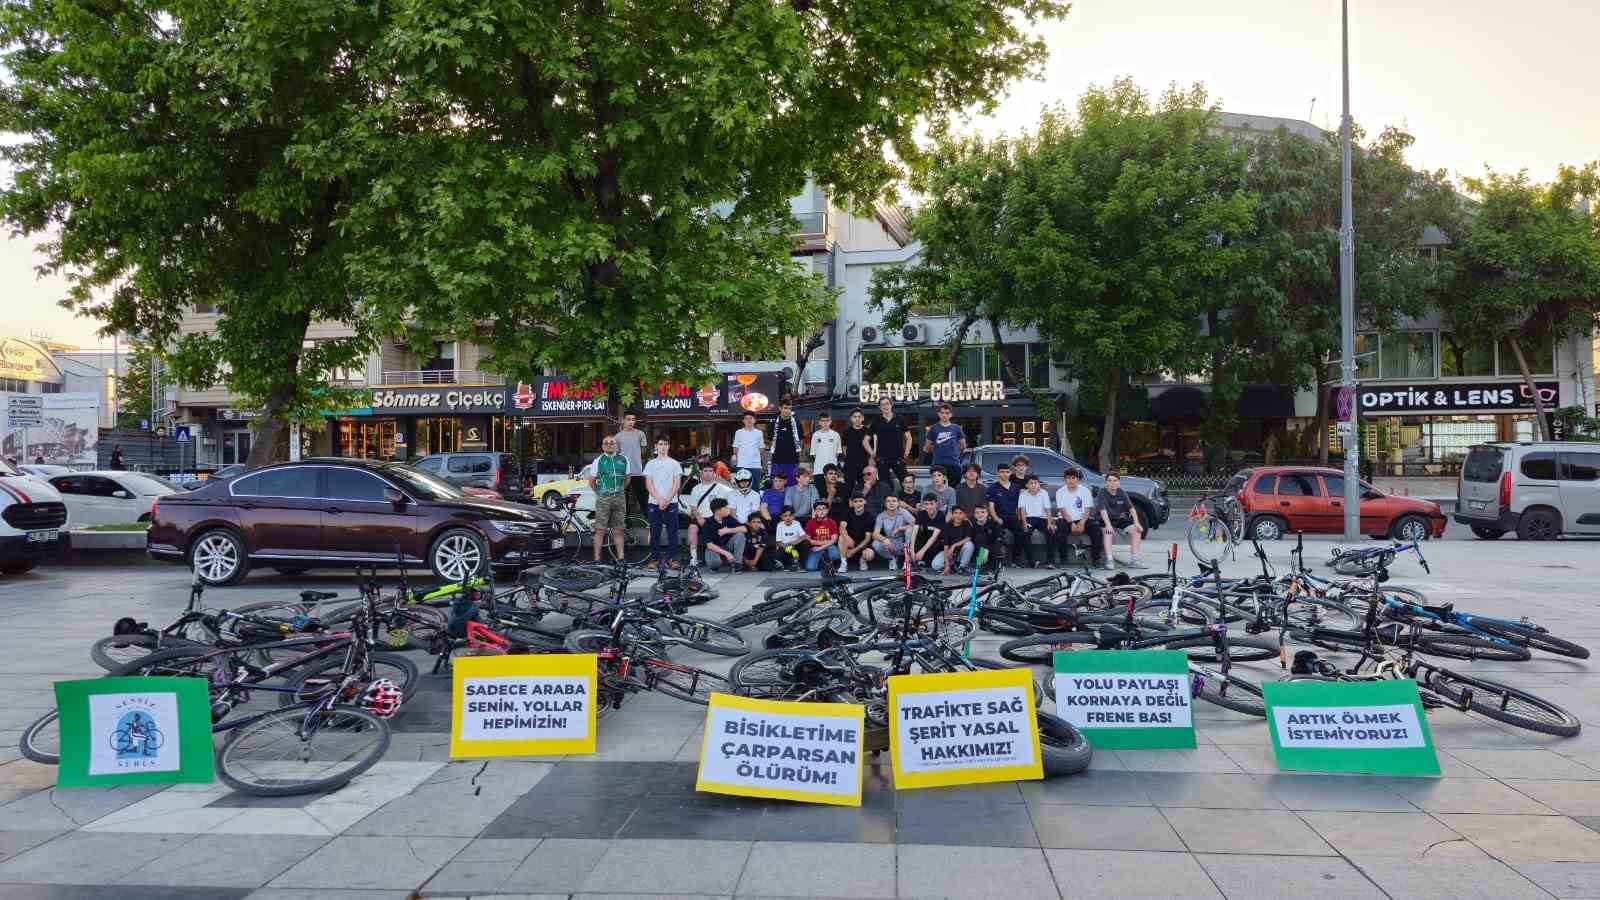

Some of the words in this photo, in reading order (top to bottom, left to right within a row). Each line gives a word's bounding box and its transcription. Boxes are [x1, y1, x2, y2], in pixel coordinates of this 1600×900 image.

[371, 390, 441, 408] Sönmez
[859, 382, 920, 403] CAJUN
[930, 380, 1006, 402] CORNER
[1362, 387, 1429, 407] OPTİK
[1433, 390, 1448, 406] &
[1454, 389, 1514, 406] LENS
[661, 398, 692, 409] SALONU
[466, 684, 528, 696] SADECE
[532, 684, 586, 695] ARABA
[1073, 679, 1113, 690] YOLU
[1117, 679, 1180, 694] PAYLAŞ!
[468, 698, 519, 713] SENİN.
[523, 701, 583, 712] YOLLAR
[1067, 695, 1142, 707] KORNAYA
[1145, 692, 1189, 707] DEĞİL
[901, 700, 983, 721] TRAFİKTE
[987, 696, 1024, 716] SAĞ
[483, 714, 568, 730] HEPİMİZİN!
[1086, 712, 1135, 723] FRENE
[1138, 712, 1173, 723] BAS!
[1287, 713, 1338, 725] ARTIK
[1341, 711, 1403, 725] ÖLMEK
[724, 717, 857, 744] BİSİKLETİME
[909, 720, 957, 744] ŞERİT
[960, 720, 1020, 737] YASAL
[1287, 726, 1409, 740] İSTEMİYORUZ!
[721, 741, 856, 765] ÇARPARSAN
[736, 760, 838, 785] ÖLÜRÜM!
